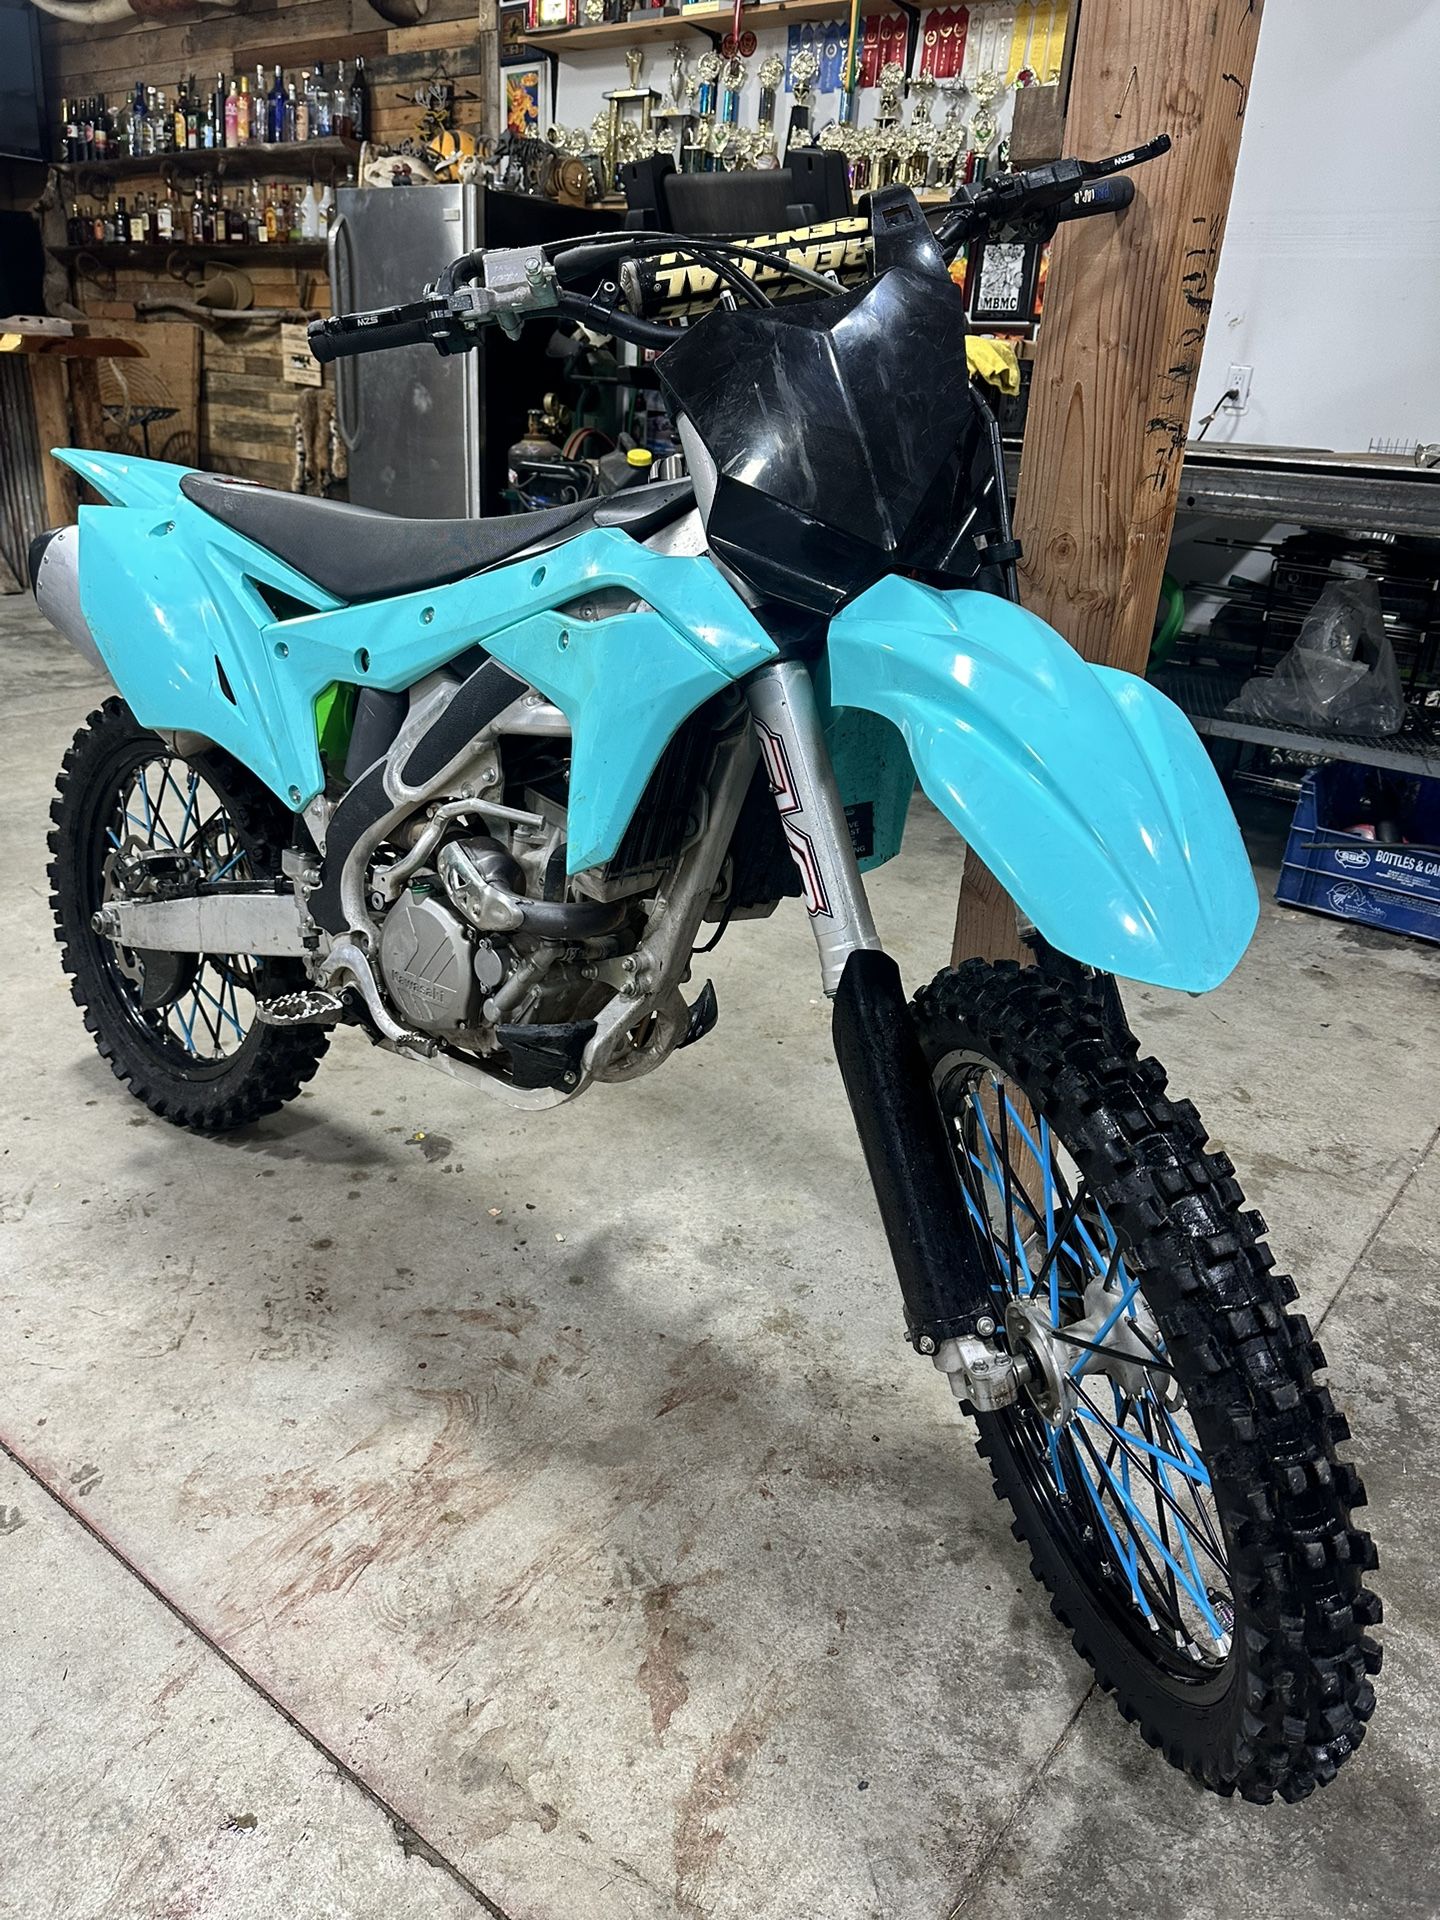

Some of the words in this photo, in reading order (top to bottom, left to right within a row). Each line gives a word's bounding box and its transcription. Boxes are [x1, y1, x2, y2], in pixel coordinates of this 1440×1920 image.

[983, 297, 1017, 309] MBMC
[1375, 849, 1415, 870] BOTTLES
[1415, 860, 1424, 873] &
[391, 969, 445, 1002] Kawasaki
